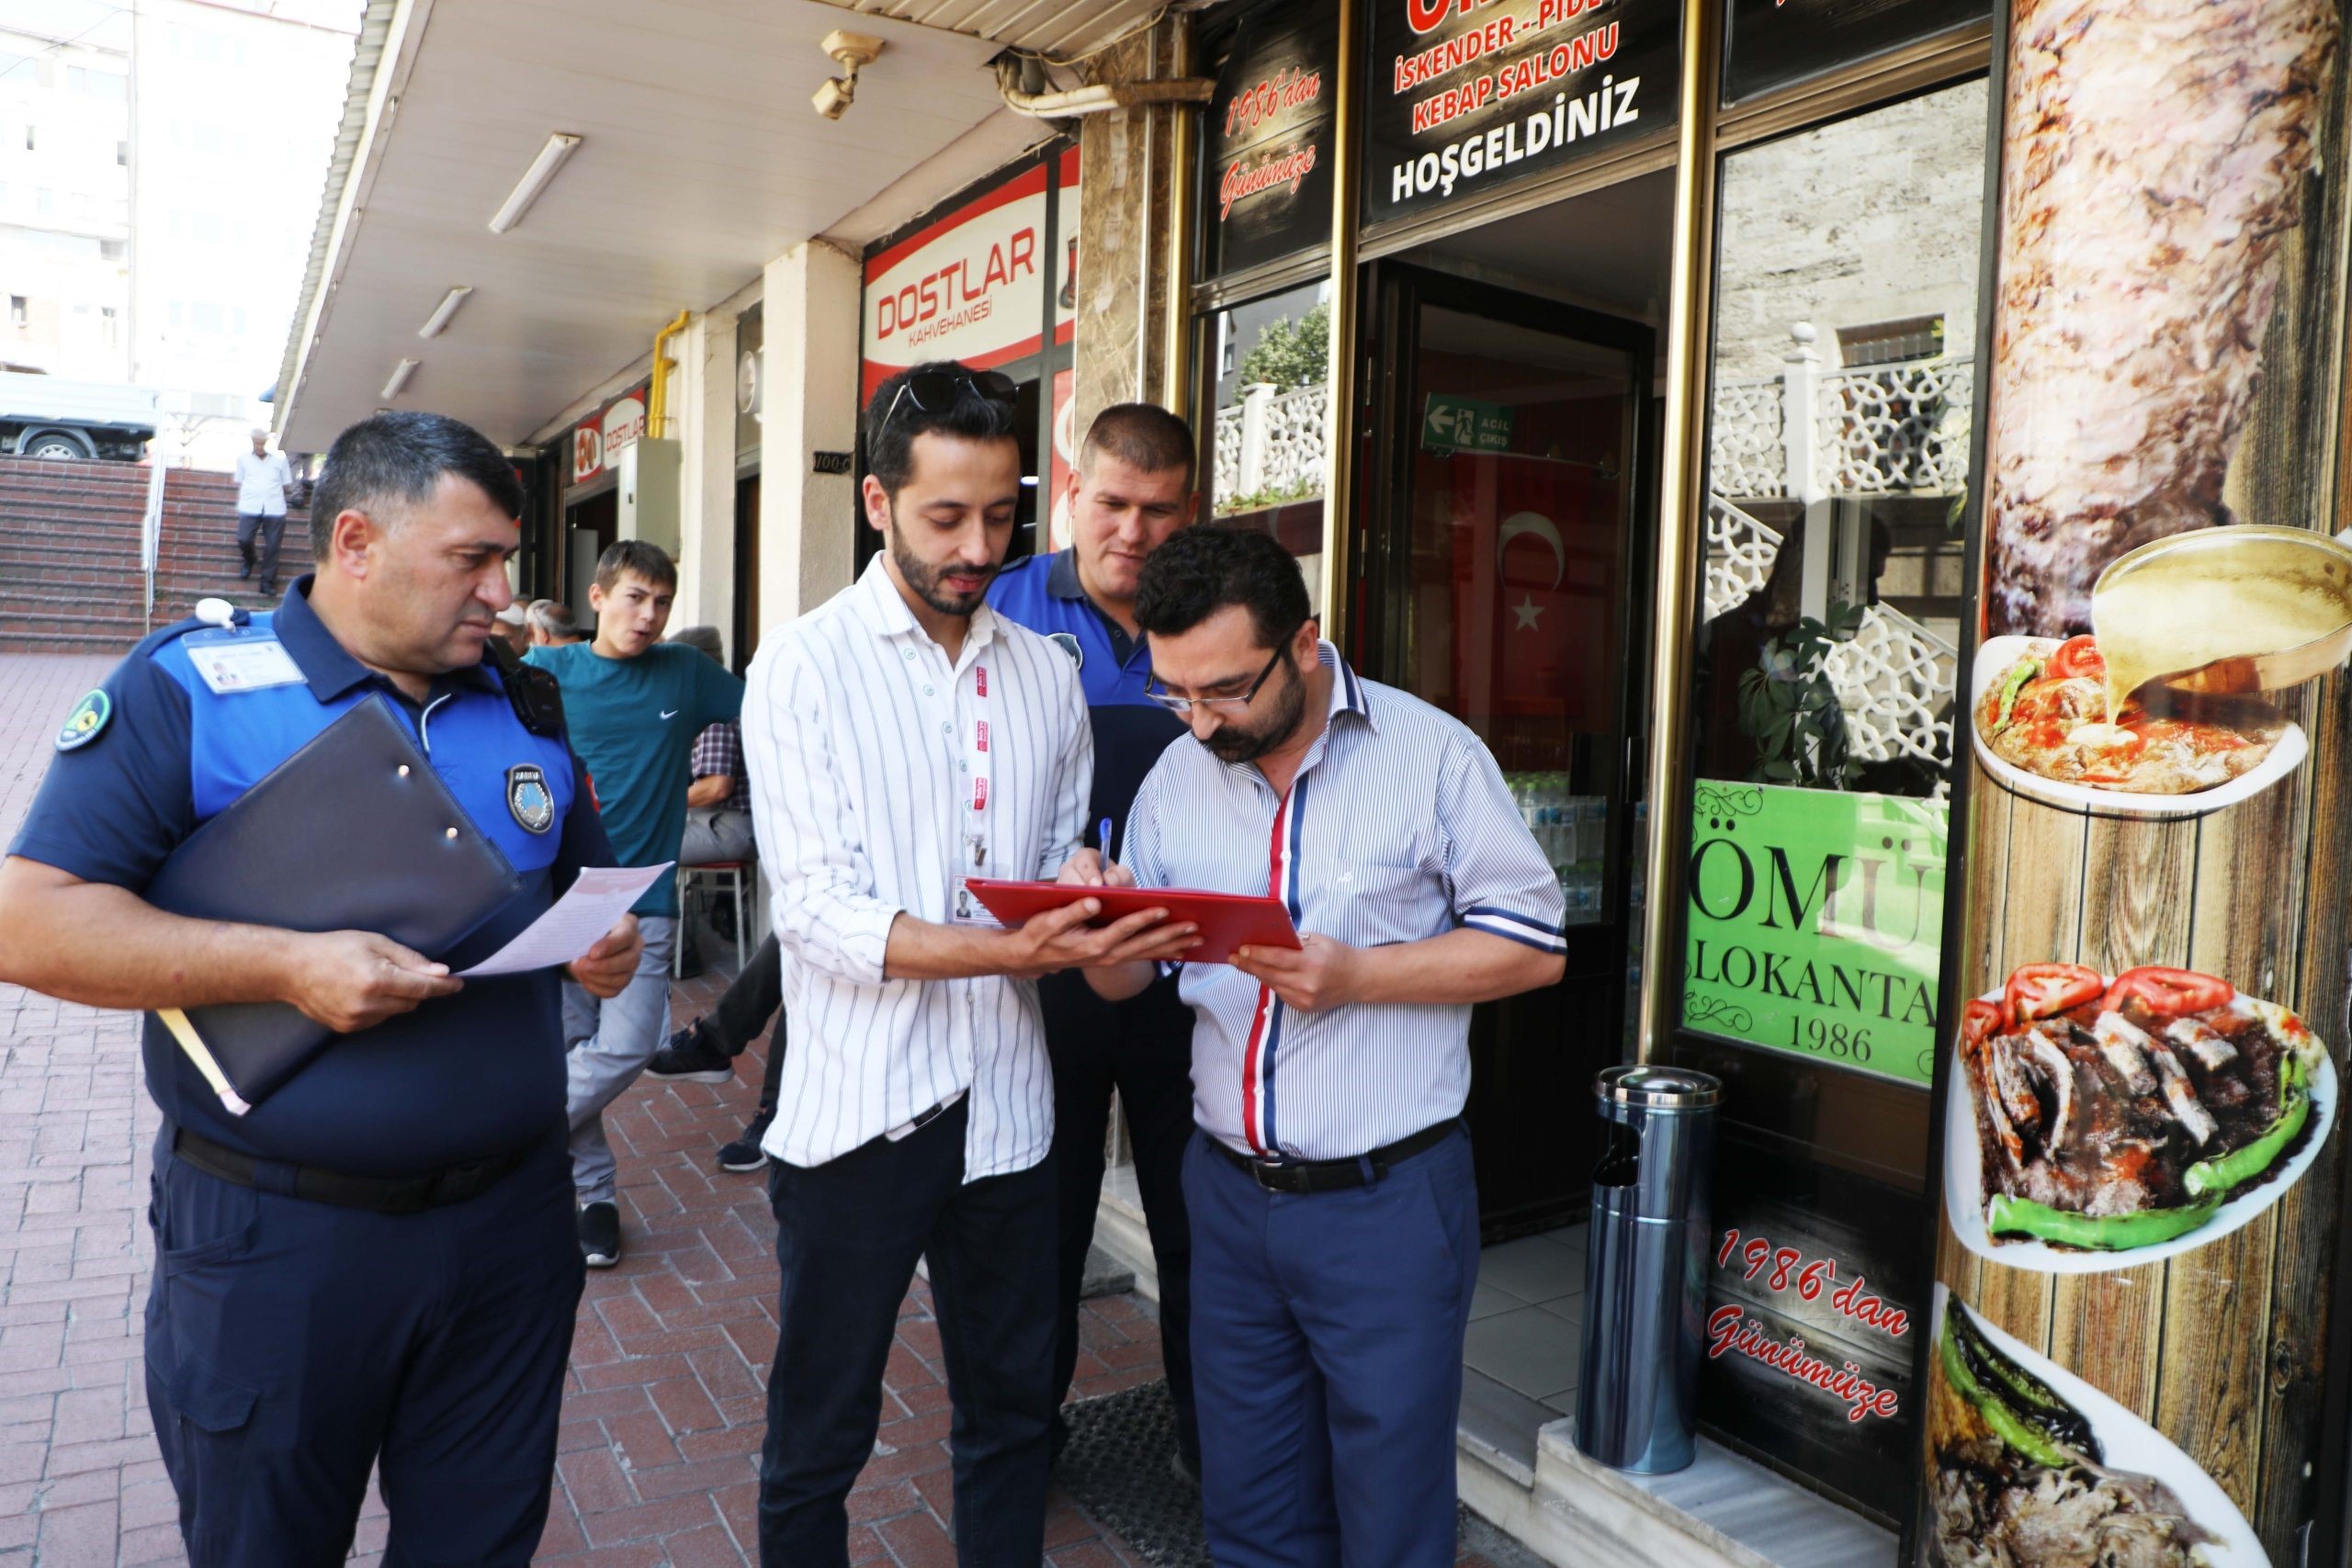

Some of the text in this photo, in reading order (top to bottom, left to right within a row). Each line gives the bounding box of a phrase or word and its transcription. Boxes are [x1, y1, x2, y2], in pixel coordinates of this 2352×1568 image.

[1225, 66, 1321, 138] 1986'dan
[1394, 15, 1515, 96] İSKENDER
[1413, 21, 1620, 135] KEBAP SALONU
[1220, 143, 1316, 221] Günümüze
[1392, 74, 1641, 203] HOŞGELDİNİZ
[878, 226, 1035, 341] DOSTLAR
[908, 294, 992, 348] KAHVEHANESİ
[1690, 817, 1946, 950] ÖMÜ
[1791, 1015, 1872, 1062] 1986
[1717, 1228, 1909, 1337] 1986'dan
[1708, 1303, 1899, 1422] Günümüze
